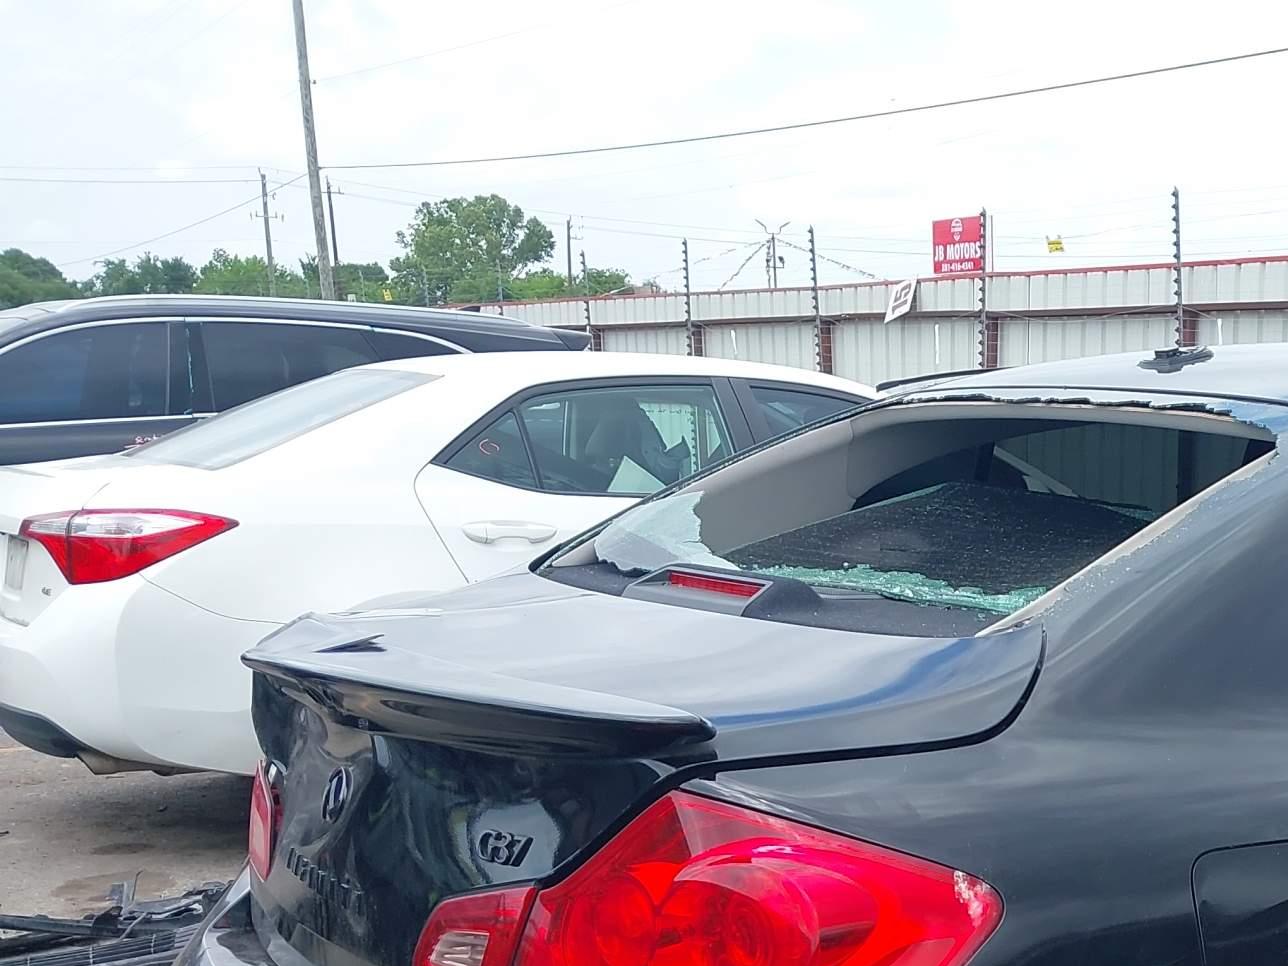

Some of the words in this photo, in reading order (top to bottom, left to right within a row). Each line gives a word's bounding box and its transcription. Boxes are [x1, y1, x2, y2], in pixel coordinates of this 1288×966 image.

[934, 245, 945, 261] JB
[946, 241, 981, 260] MOTORS
[477, 828, 534, 868] G37
